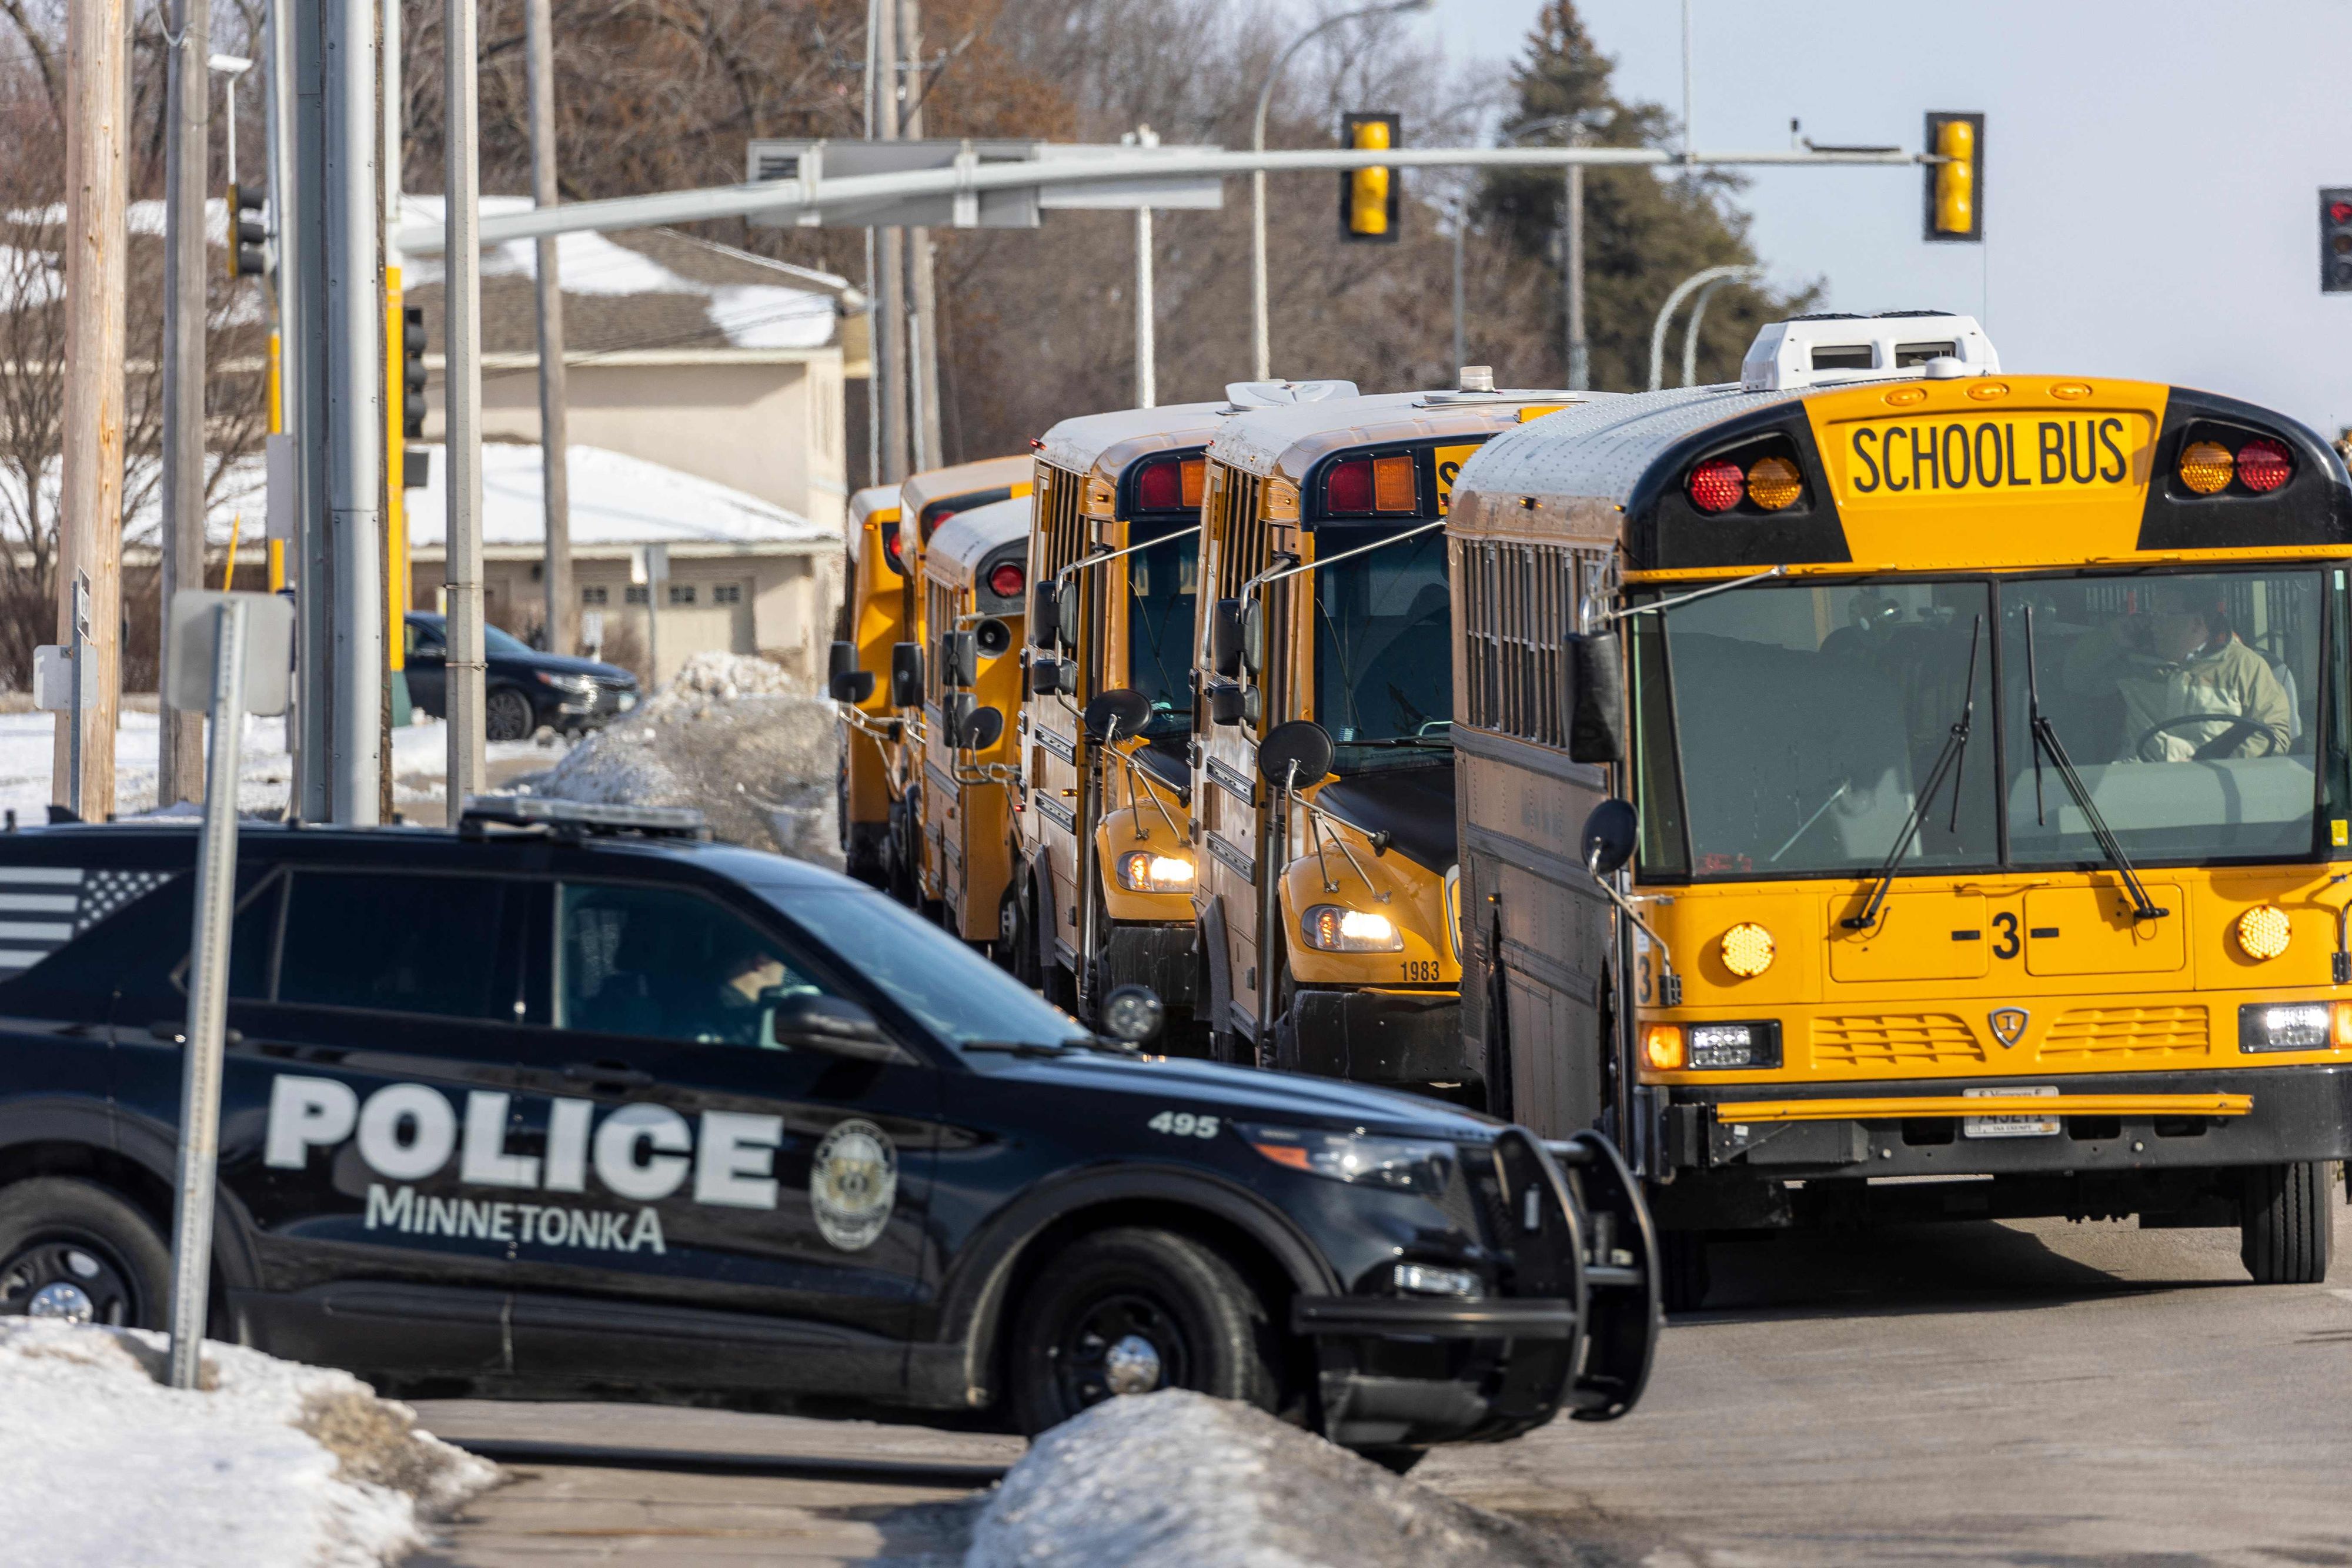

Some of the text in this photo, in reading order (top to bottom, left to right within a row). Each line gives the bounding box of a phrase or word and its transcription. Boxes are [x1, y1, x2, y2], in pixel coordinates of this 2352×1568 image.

[1852, 418, 2127, 493] SCHOOL BUS
[1401, 960, 1439, 981] 1983
[263, 1074, 784, 1211] POLICE
[1147, 1111, 1220, 1139] 495
[364, 1183, 666, 1255] MINNETONKA
